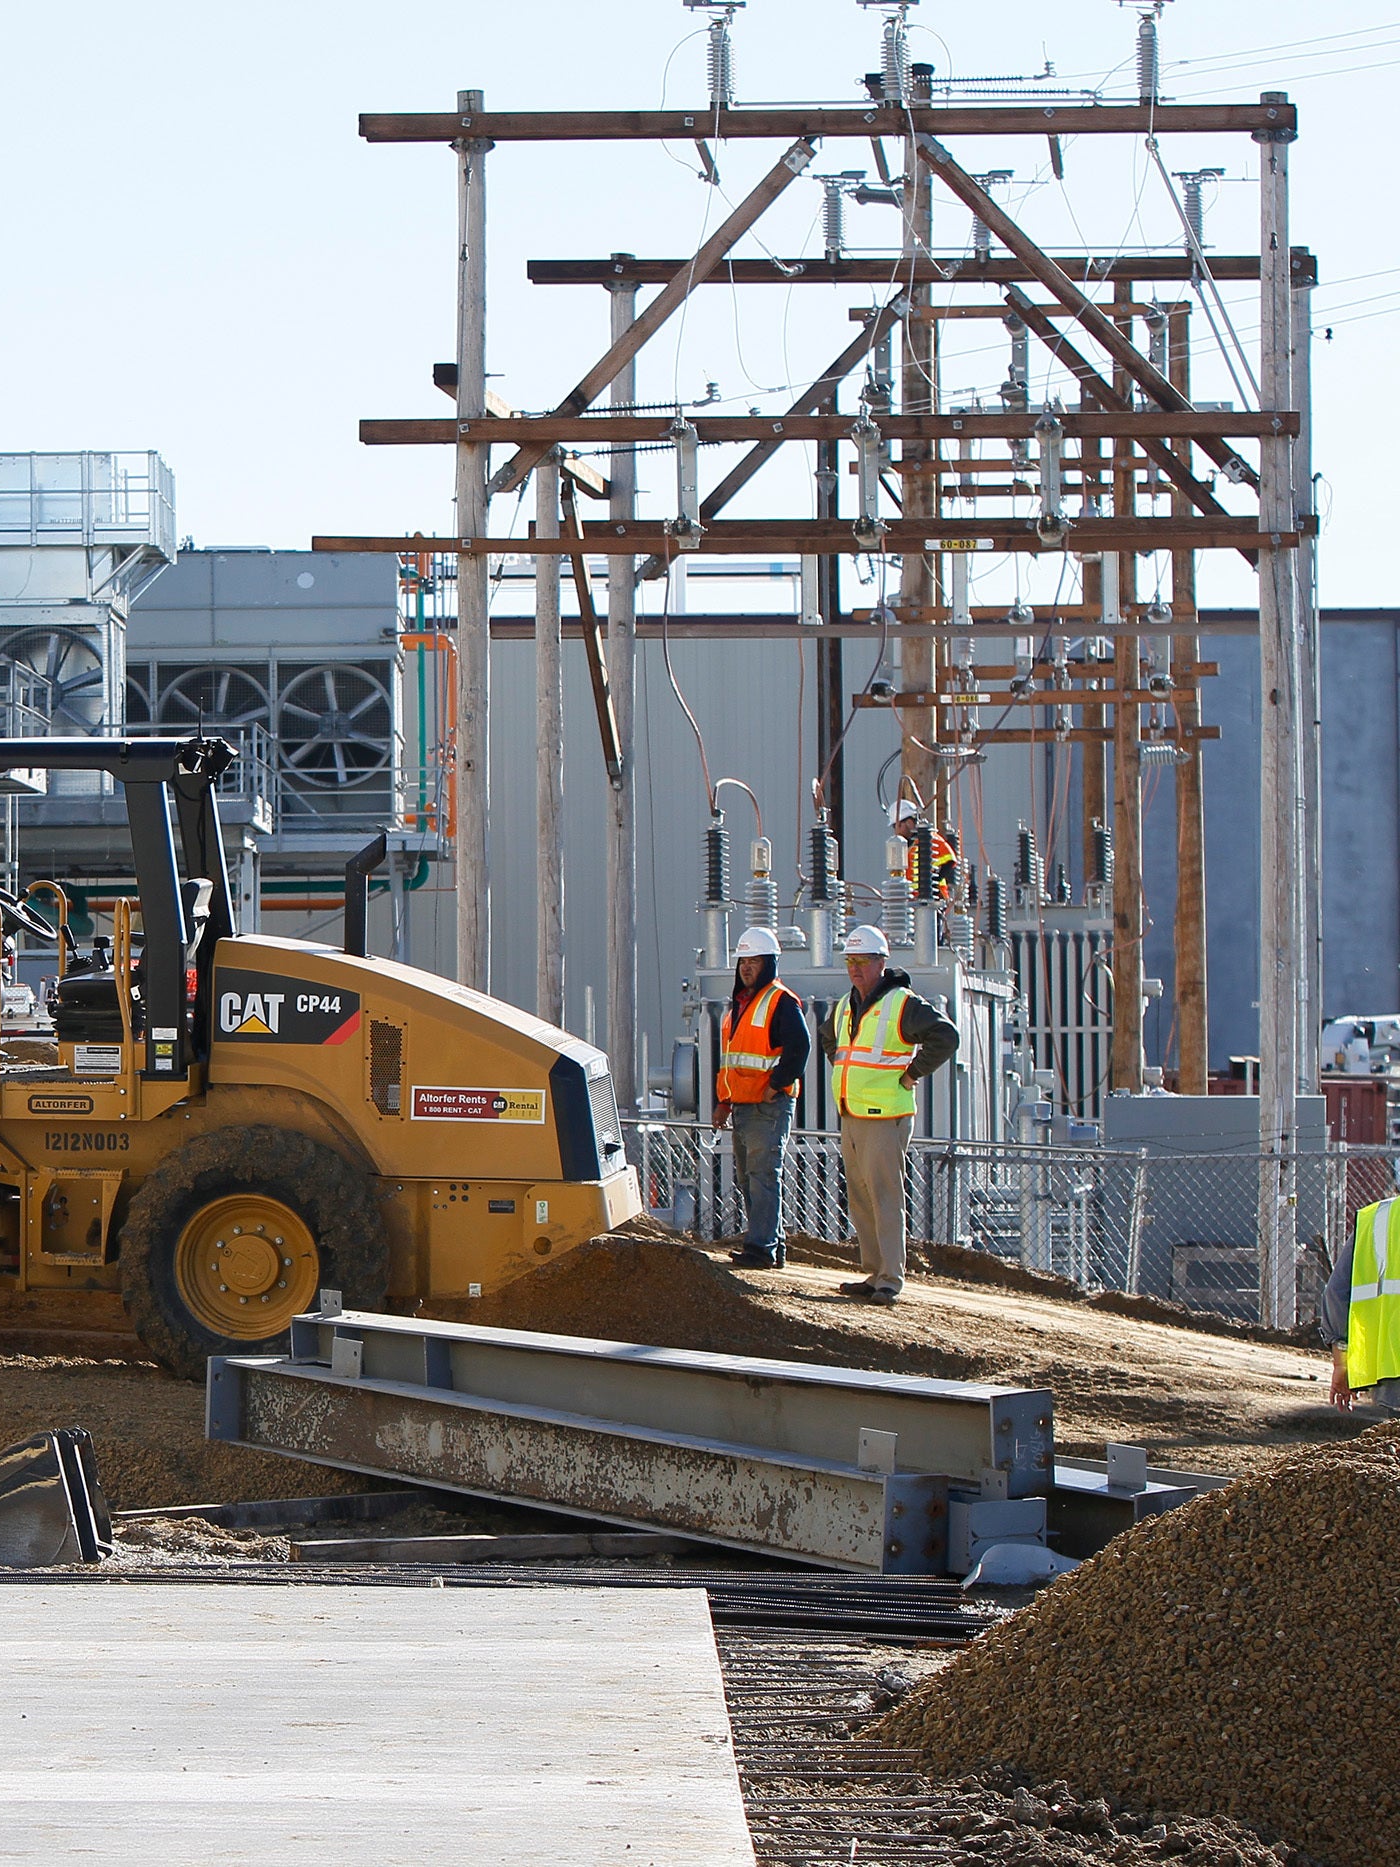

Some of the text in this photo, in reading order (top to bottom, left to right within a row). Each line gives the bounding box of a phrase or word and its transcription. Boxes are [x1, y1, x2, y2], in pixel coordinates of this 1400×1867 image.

[940, 540, 977, 549] 60-087
[220, 992, 342, 1034] CAT CP44
[419, 1093, 487, 1104] Altorfer Rents
[493, 1101, 538, 1110] CAT Rental
[45, 1132, 130, 1151] 1212N003
